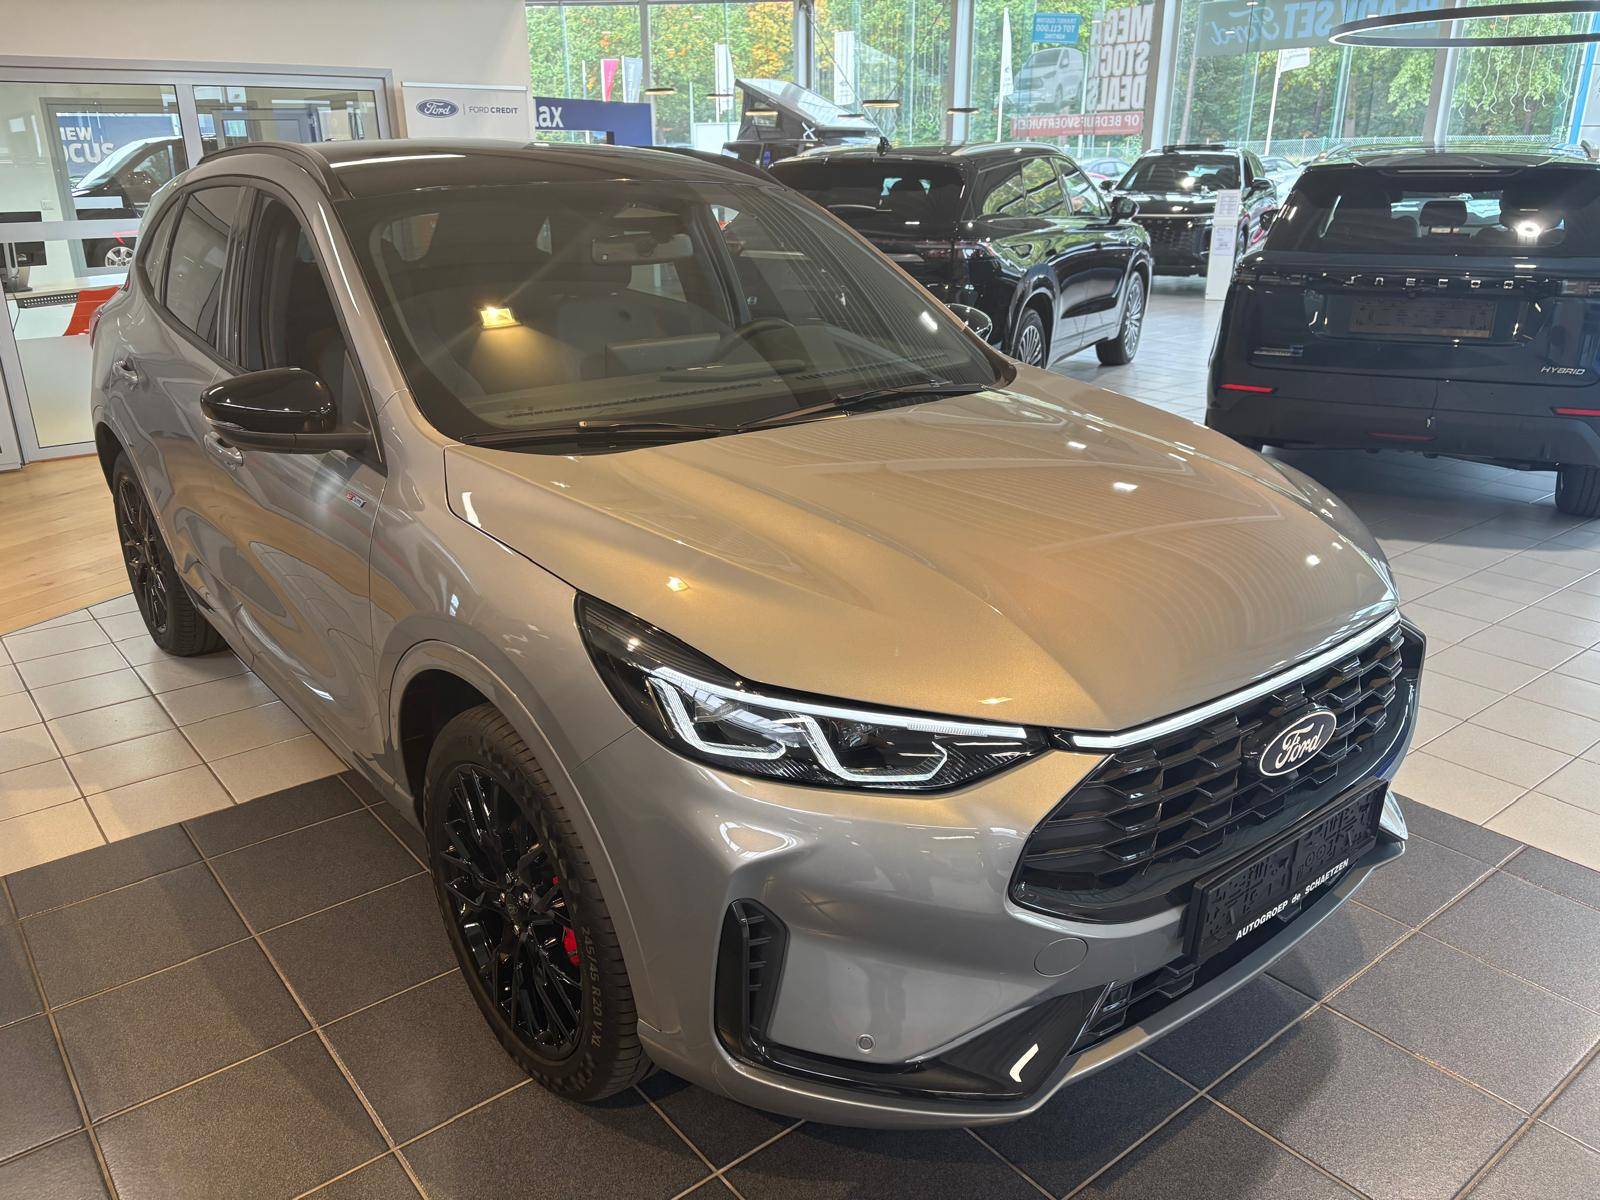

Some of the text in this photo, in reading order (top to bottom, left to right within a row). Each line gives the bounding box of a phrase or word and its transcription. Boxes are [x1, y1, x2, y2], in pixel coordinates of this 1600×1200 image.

[424, 100, 452, 116] Ford
[468, 105, 519, 115] FORD CREDIT
[535, 105, 564, 128] ax
[1540, 366, 1586, 375] HYBRID
[1275, 722, 1325, 769] Ford
[1235, 858, 1350, 941] AUTOGROEP de SCHAETZEN
